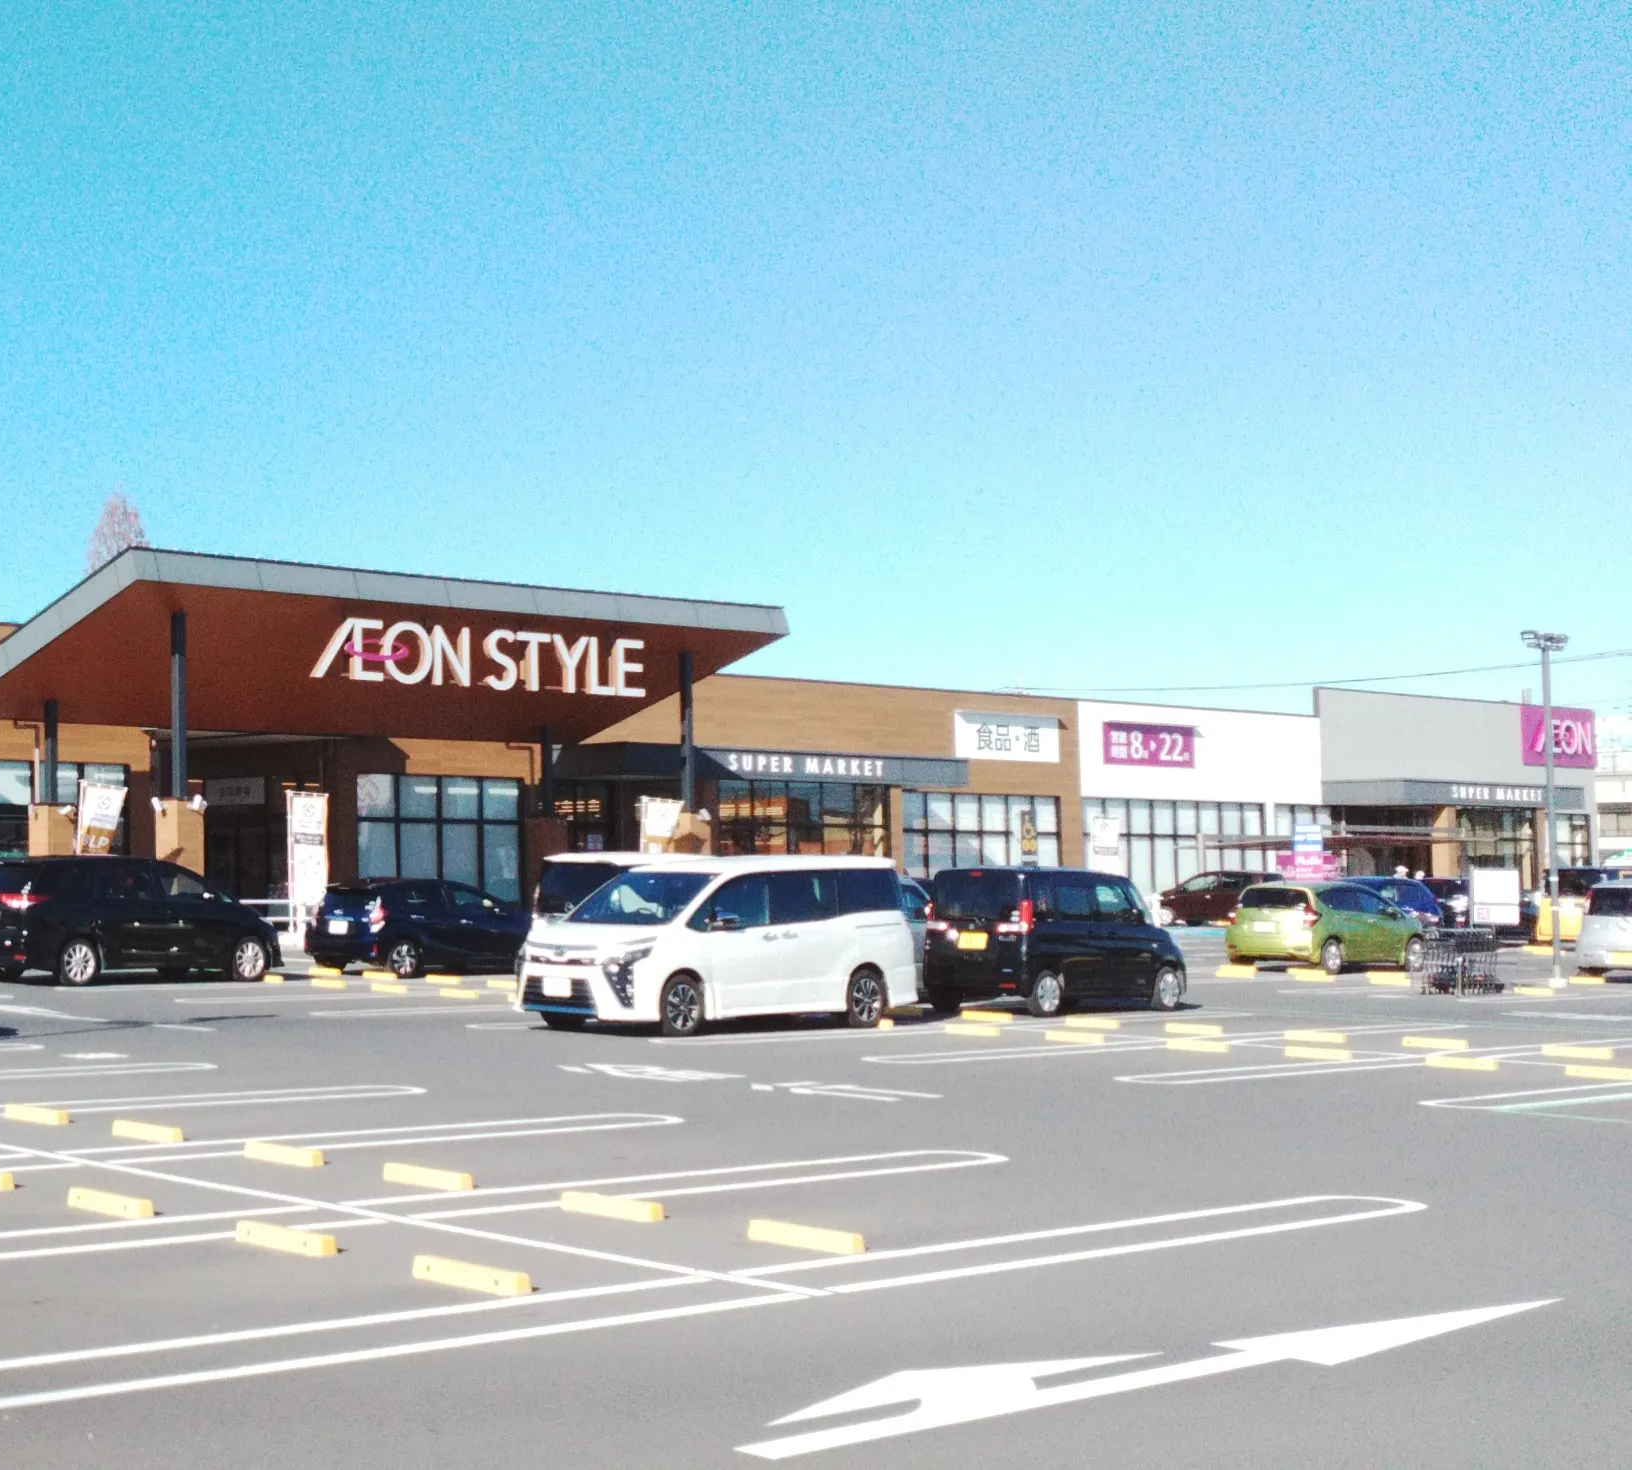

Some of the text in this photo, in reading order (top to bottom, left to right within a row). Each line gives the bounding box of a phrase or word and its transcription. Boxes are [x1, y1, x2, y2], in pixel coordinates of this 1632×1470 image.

[483, 629, 646, 698] STYLE
[976, 722, 1041, 753] 食品・酒
[728, 753, 884, 778] SUPER MARKET
[1451, 786, 1543, 802] SUPER MARKET
